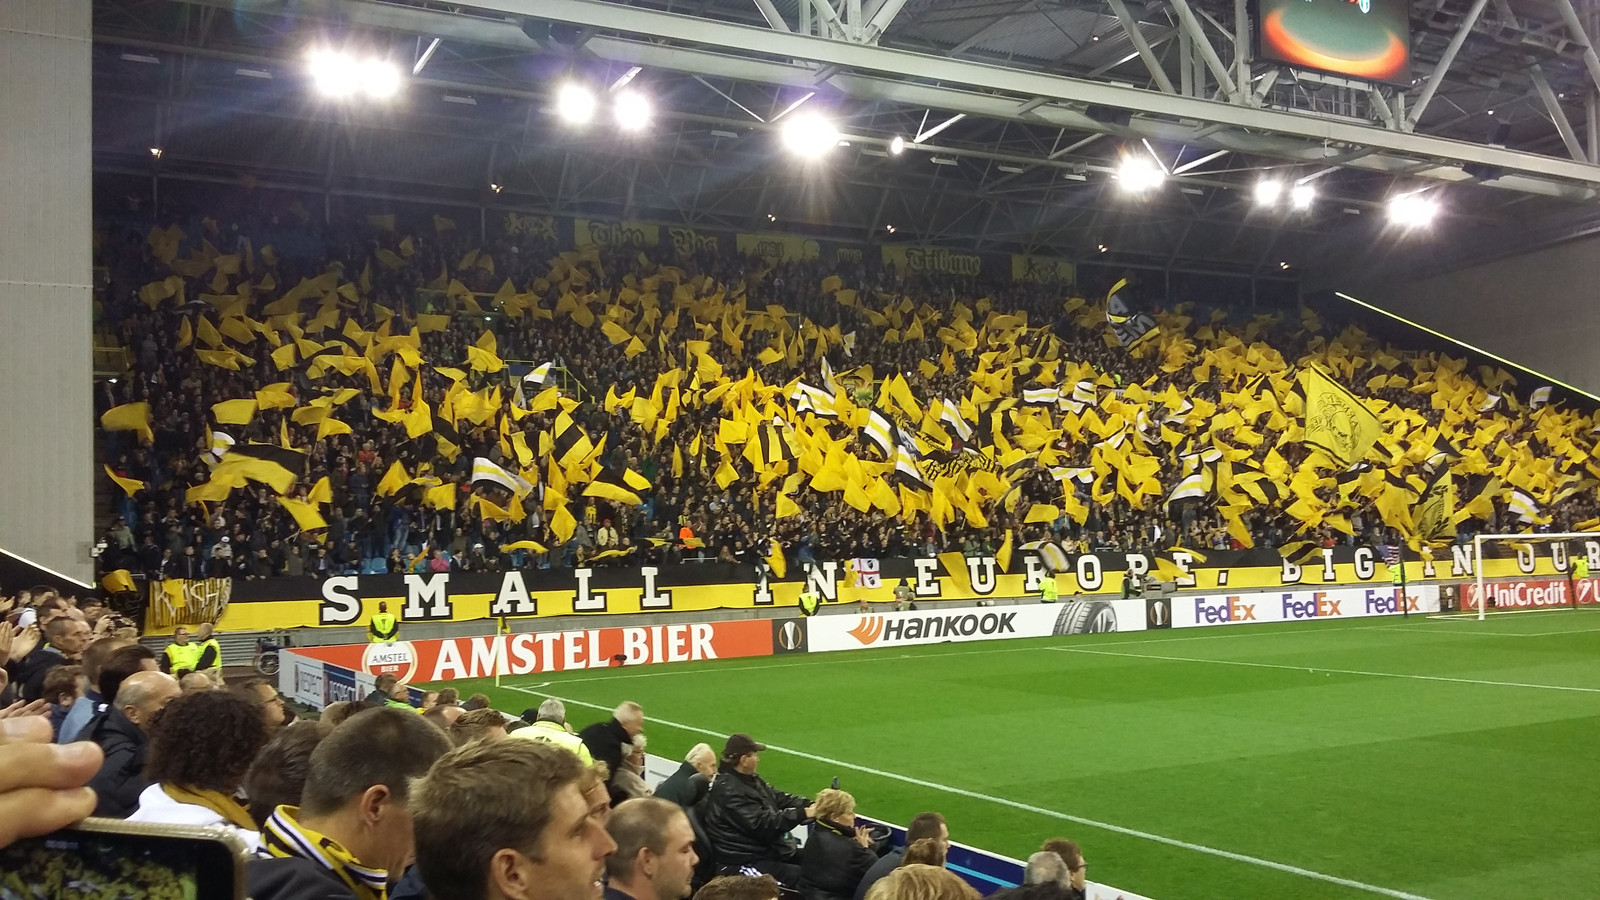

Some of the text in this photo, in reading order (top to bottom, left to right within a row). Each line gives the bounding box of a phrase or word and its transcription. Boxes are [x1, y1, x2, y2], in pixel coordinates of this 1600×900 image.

[322, 566, 671, 622] SMALL
[755, 561, 838, 603] IN
[1281, 547, 1374, 583] BIG
[1422, 544, 1474, 577] IN
[1486, 580, 1567, 607] UniCredit
[1195, 595, 1257, 624] FedEx
[1282, 592, 1342, 619] FedEx
[1365, 588, 1420, 614] FedEx
[371, 652, 409, 664] AMSTEL
[430, 622, 719, 682] AMSTEL BIER
[380, 664, 400, 673] BIER
